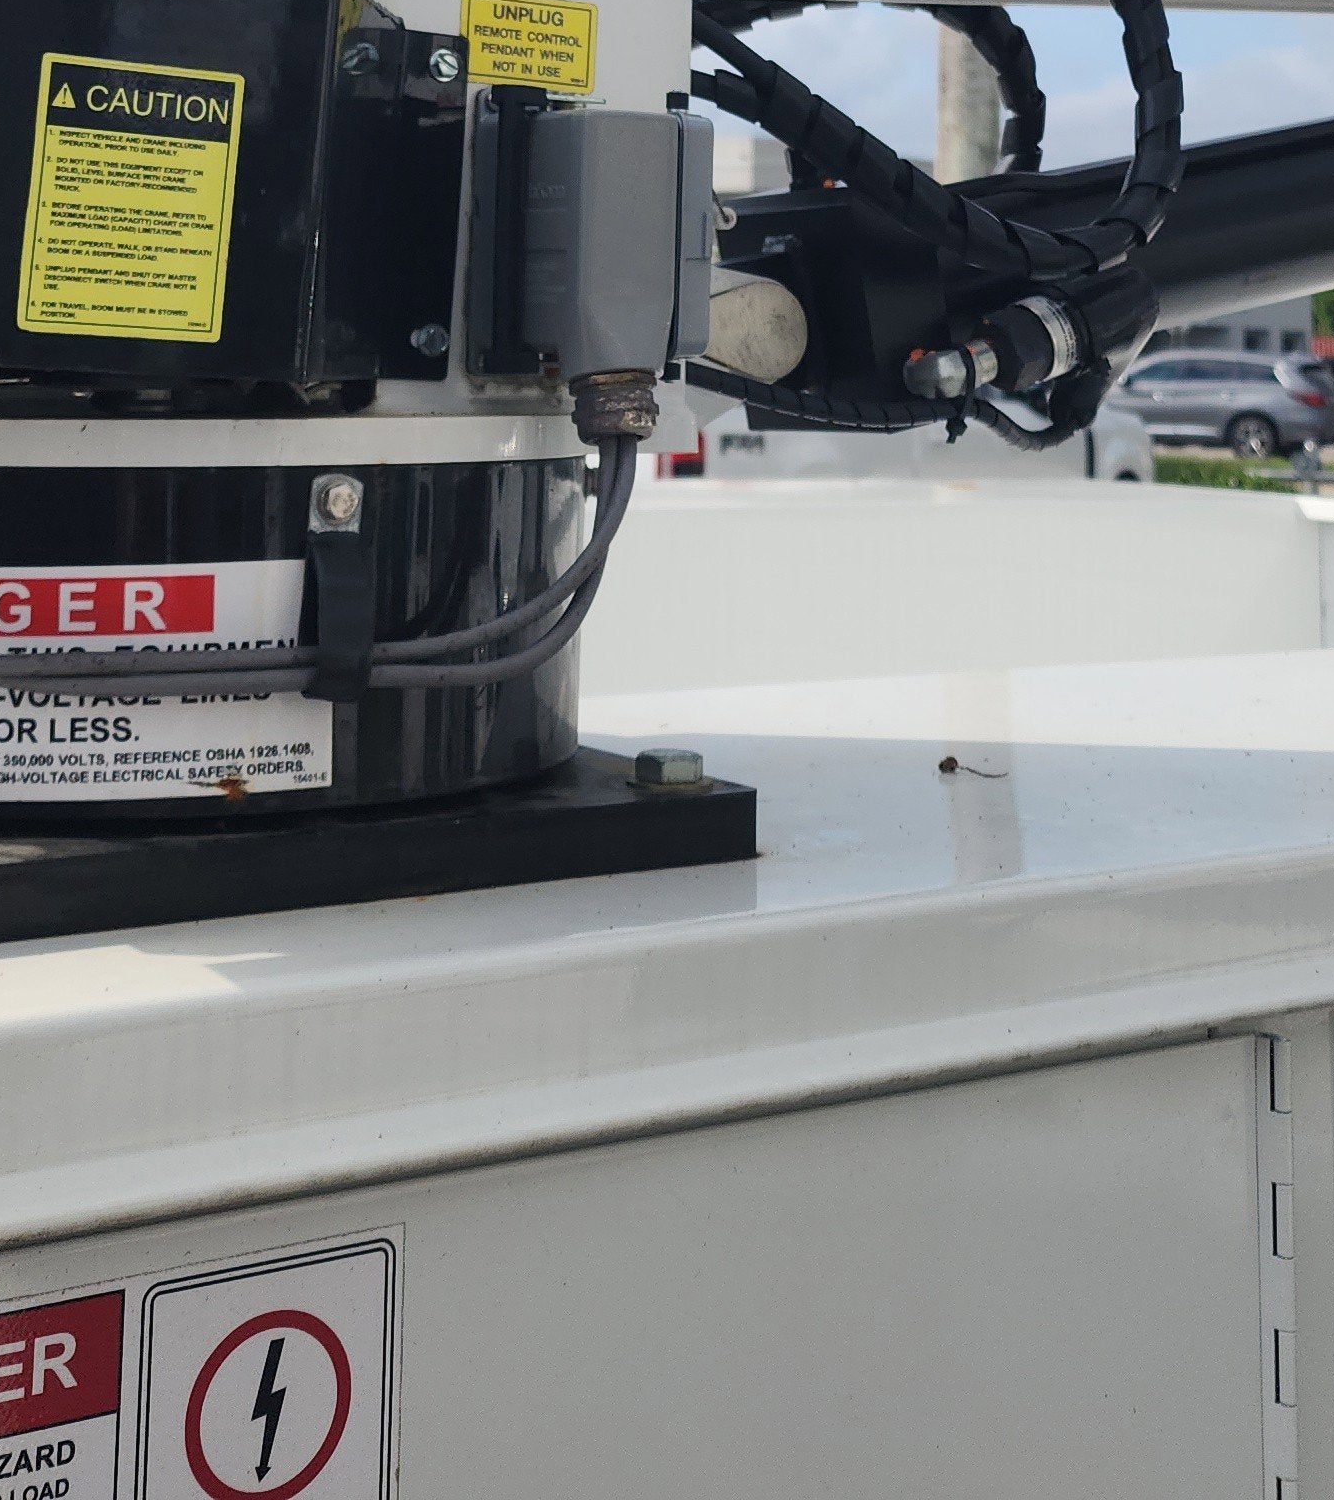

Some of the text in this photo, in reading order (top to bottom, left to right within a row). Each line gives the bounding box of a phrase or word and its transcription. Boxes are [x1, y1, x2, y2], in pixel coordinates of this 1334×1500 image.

[493, 4, 564, 27] UNPLUG
[474, 24, 582, 48] REMOTE CONTROL
[481, 42, 574, 63] PENDANT WHEN
[492, 60, 562, 78] NOT IN USE
[86, 85, 230, 125] CAUTION
[51, 201, 82, 211] BEFORE
[83, 204, 127, 215] OPERATING
[128, 207, 143, 215] THE
[172, 211, 196, 220] REFER
[197, 213, 207, 221] TO
[47, 246, 70, 255] BOOM
[91, 250, 136, 260] SUSPENDED
[41, 301, 57, 309] FOR
[91, 304, 114, 312] BOOM
[116, 305, 136, 313] MUST
[137, 307, 147, 315] BE
[157, 308, 189, 317] STOWED
[49, 716, 140, 743] LESS.
[58, 753, 109, 768] VOLTS,
[114, 749, 201, 765] REFERENCE
[205, 746, 246, 761] OSHA
[93, 767, 185, 783] ELECTRICAL
[188, 764, 243, 780] SAFETY
[247, 759, 306, 776] ORDERS.
